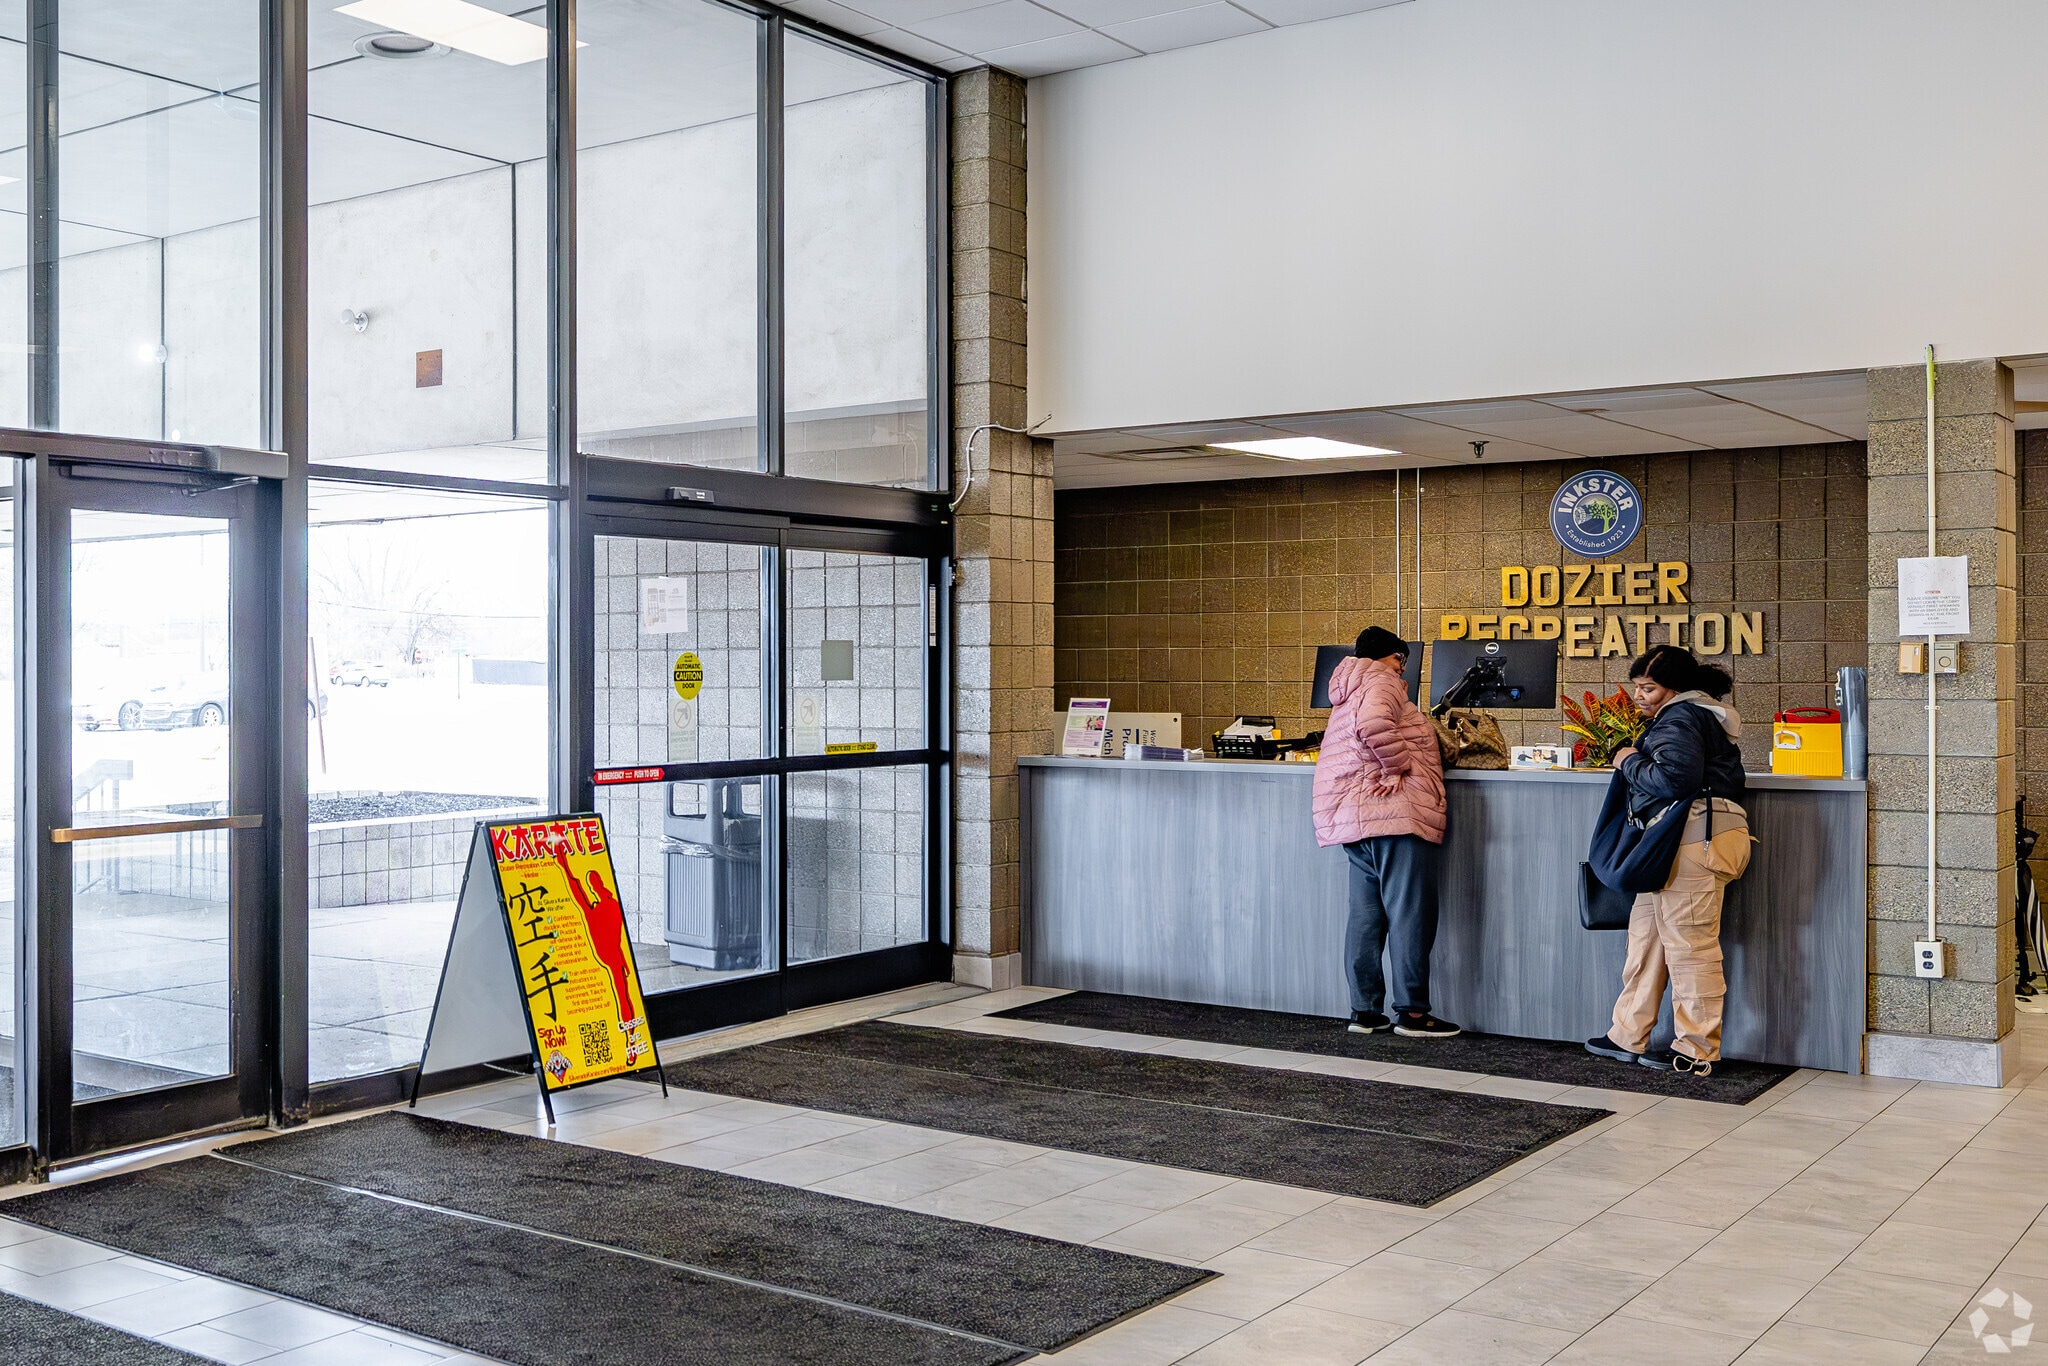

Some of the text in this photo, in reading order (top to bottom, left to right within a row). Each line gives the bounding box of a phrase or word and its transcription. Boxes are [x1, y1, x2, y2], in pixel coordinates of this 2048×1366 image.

[1558, 478, 1633, 513] INKSTER
[1567, 529, 1623, 548] Established 1923
[1501, 562, 1688, 607] DOZIER
[675, 671, 702, 681] CAUTION
[489, 819, 605, 862] KARATE
[538, 1025, 567, 1039] Sign Up
[618, 1016, 645, 1033] Classes
[544, 1036, 567, 1049] NOW!
[629, 1032, 641, 1043] are
[626, 1041, 649, 1058] FREE
